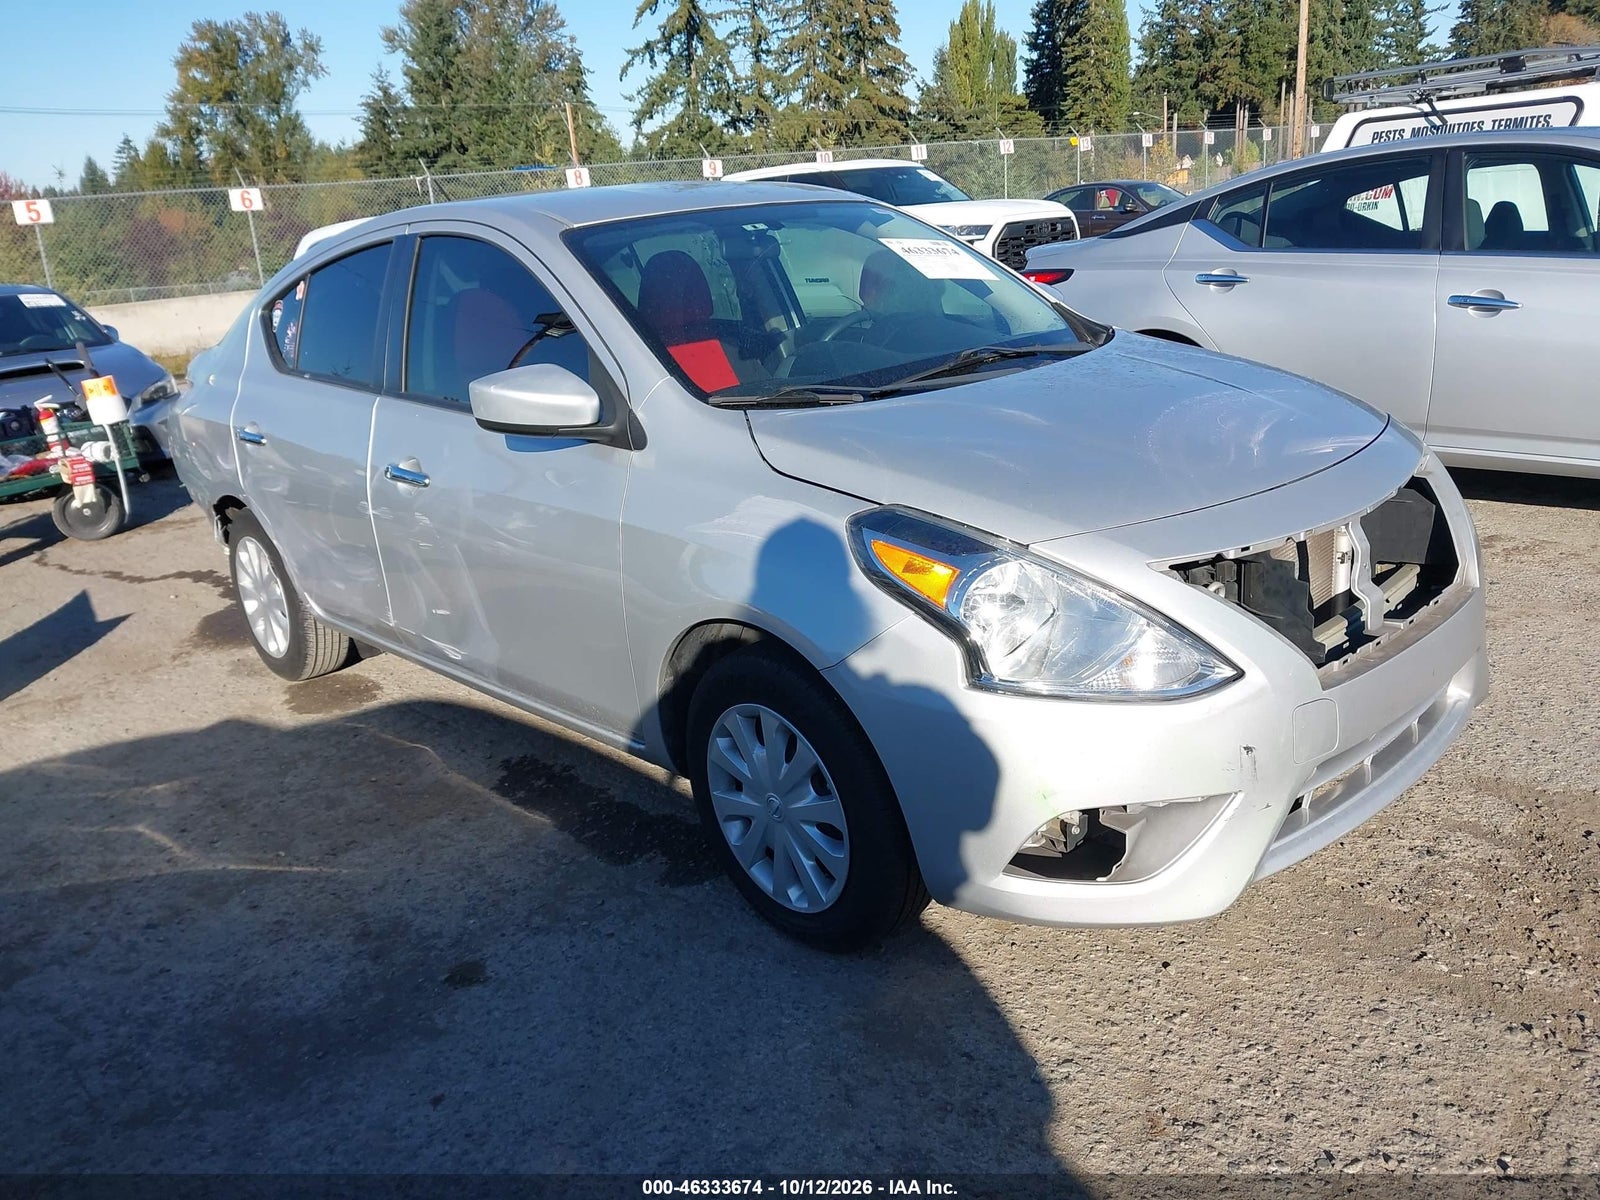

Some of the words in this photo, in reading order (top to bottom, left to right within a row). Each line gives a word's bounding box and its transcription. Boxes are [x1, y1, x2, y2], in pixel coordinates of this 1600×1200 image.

[1081, 138, 1090, 150] 13
[1144, 134, 1151, 145] 14
[915, 146, 923, 159] 11
[1003, 141, 1012, 153] 12
[819, 153, 831, 163] 10
[708, 161, 717, 176] 9
[574, 169, 583, 186] 8
[240, 189, 253, 209] 6
[25, 200, 42, 222] 5
